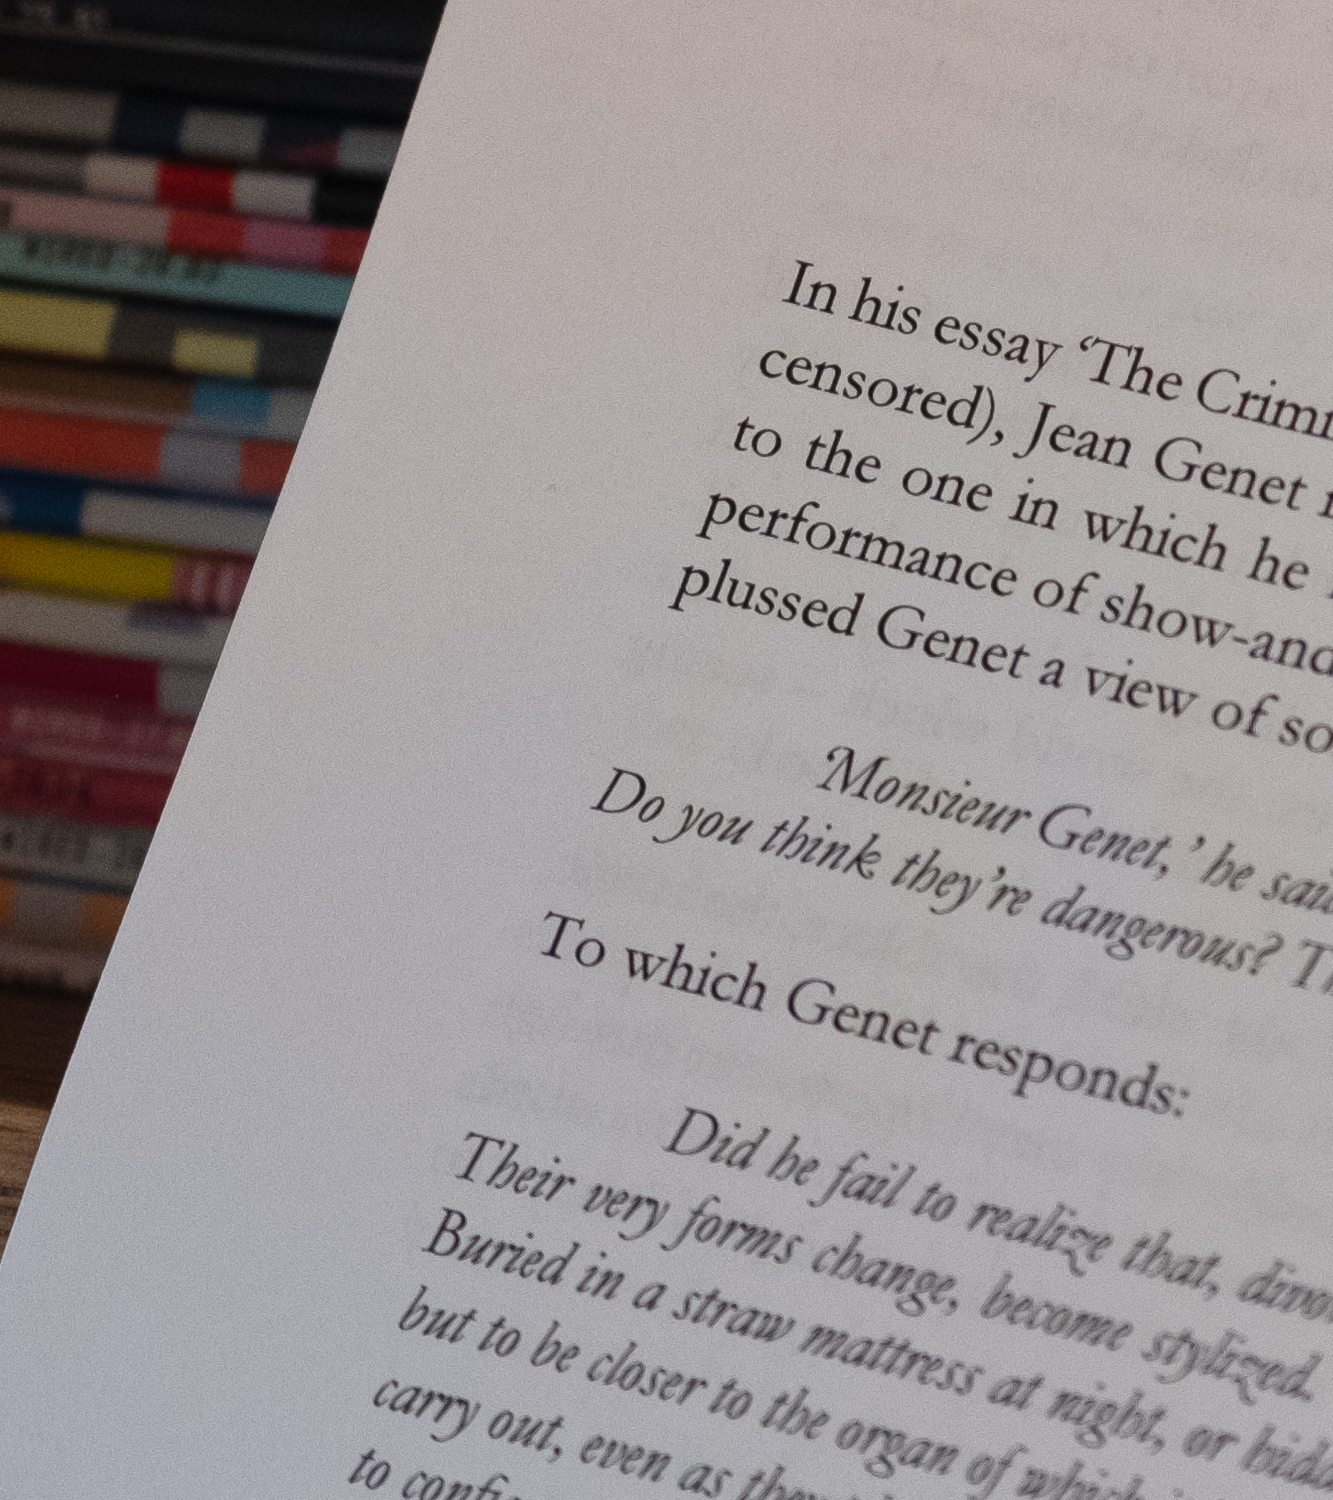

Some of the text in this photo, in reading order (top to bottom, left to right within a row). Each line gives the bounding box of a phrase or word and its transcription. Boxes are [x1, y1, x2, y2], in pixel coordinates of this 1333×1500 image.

[781, 258, 839, 317] In
[846, 274, 924, 337] his
[931, 314, 1065, 385] essay
[731, 415, 785, 460] to
[803, 427, 884, 486] the
[899, 465, 995, 515] one
[1007, 476, 1061, 533] in
[1082, 502, 1230, 574] which
[1244, 533, 1312, 593] he
[757, 347, 1007, 448] censored),
[1011, 399, 1134, 471] Jean
[1152, 434, 1310, 513] Genet
[694, 491, 1020, 599] performance
[1030, 569, 1103, 617] of
[666, 556, 867, 639] plussed
[874, 602, 1032, 681] Genet
[1036, 656, 1067, 691] a
[1084, 656, 1201, 720] view
[1209, 691, 1282, 740] of
[589, 765, 668, 825] Do
[652, 802, 756, 848] you
[757, 813, 884, 882] think
[1037, 881, 1287, 978] dangerous?
[1197, 839, 1258, 894] he
[539, 909, 1192, 1120] To which Genet responds:
[453, 1129, 962, 1320] Their very forms change,
